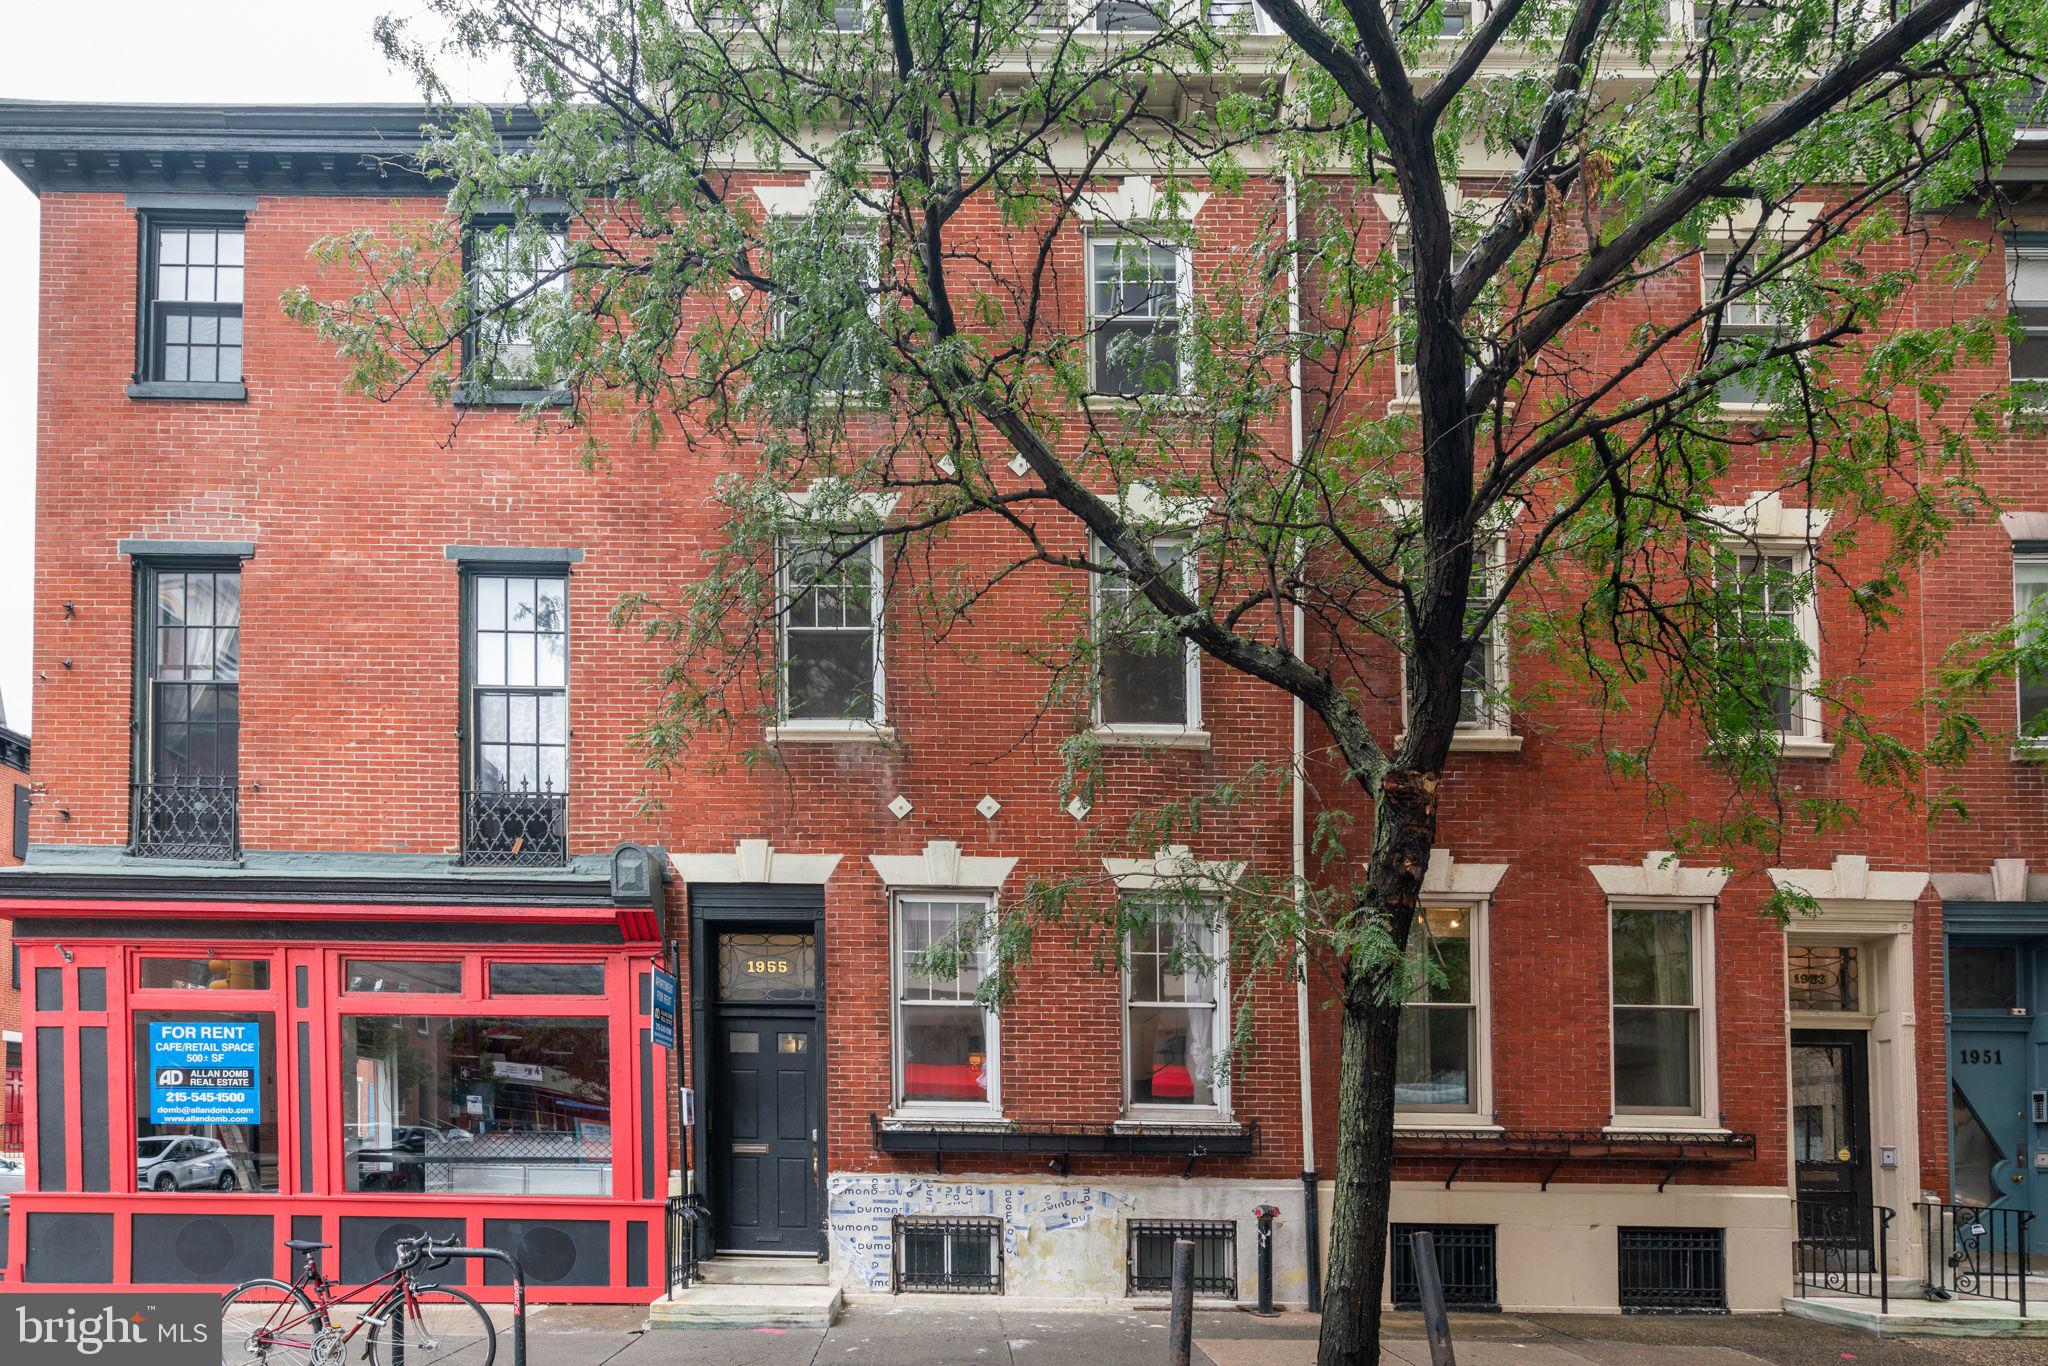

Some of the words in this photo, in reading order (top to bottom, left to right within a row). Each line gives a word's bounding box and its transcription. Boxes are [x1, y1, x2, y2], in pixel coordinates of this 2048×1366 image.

[747, 960, 788, 973] 1955
[161, 1026, 197, 1039] FOR
[200, 1026, 245, 1039] RENT
[155, 1043, 220, 1052] CAFE/RETAIL
[221, 1043, 255, 1052] SPACE
[211, 1053, 225, 1063] SF
[1960, 1049, 2003, 1065] 1951
[159, 1069, 184, 1086] AD
[190, 1069, 221, 1078] ALLAN
[222, 1069, 249, 1078] DOMB
[190, 1078, 215, 1087] REAL
[216, 1078, 250, 1087] ESTATE
[165, 1092, 246, 1103] 215-545-1500
[156, 1106, 254, 1115] domb@allandomb.com
